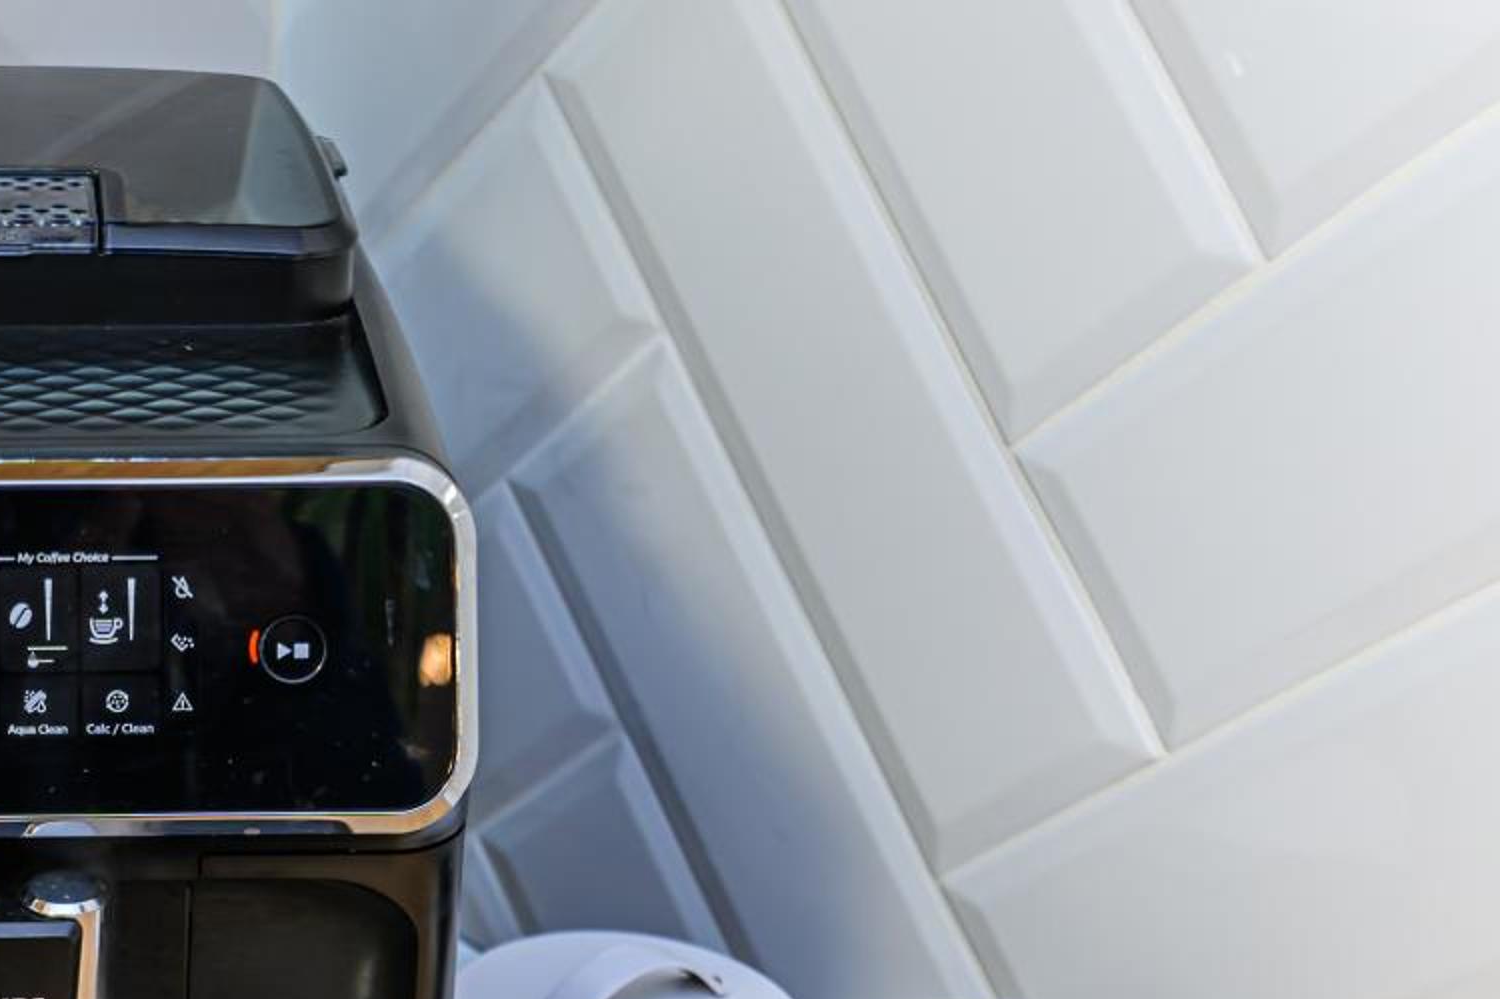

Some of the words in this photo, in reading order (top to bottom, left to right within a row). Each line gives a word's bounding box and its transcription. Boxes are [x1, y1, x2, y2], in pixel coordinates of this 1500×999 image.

[17, 552, 34, 565] My
[36, 552, 70, 565] Coffee
[72, 552, 109, 563] Choice
[7, 724, 36, 736] Aqua
[38, 724, 68, 735] Clean
[86, 723, 111, 735] Calc
[121, 723, 155, 735] Clean
